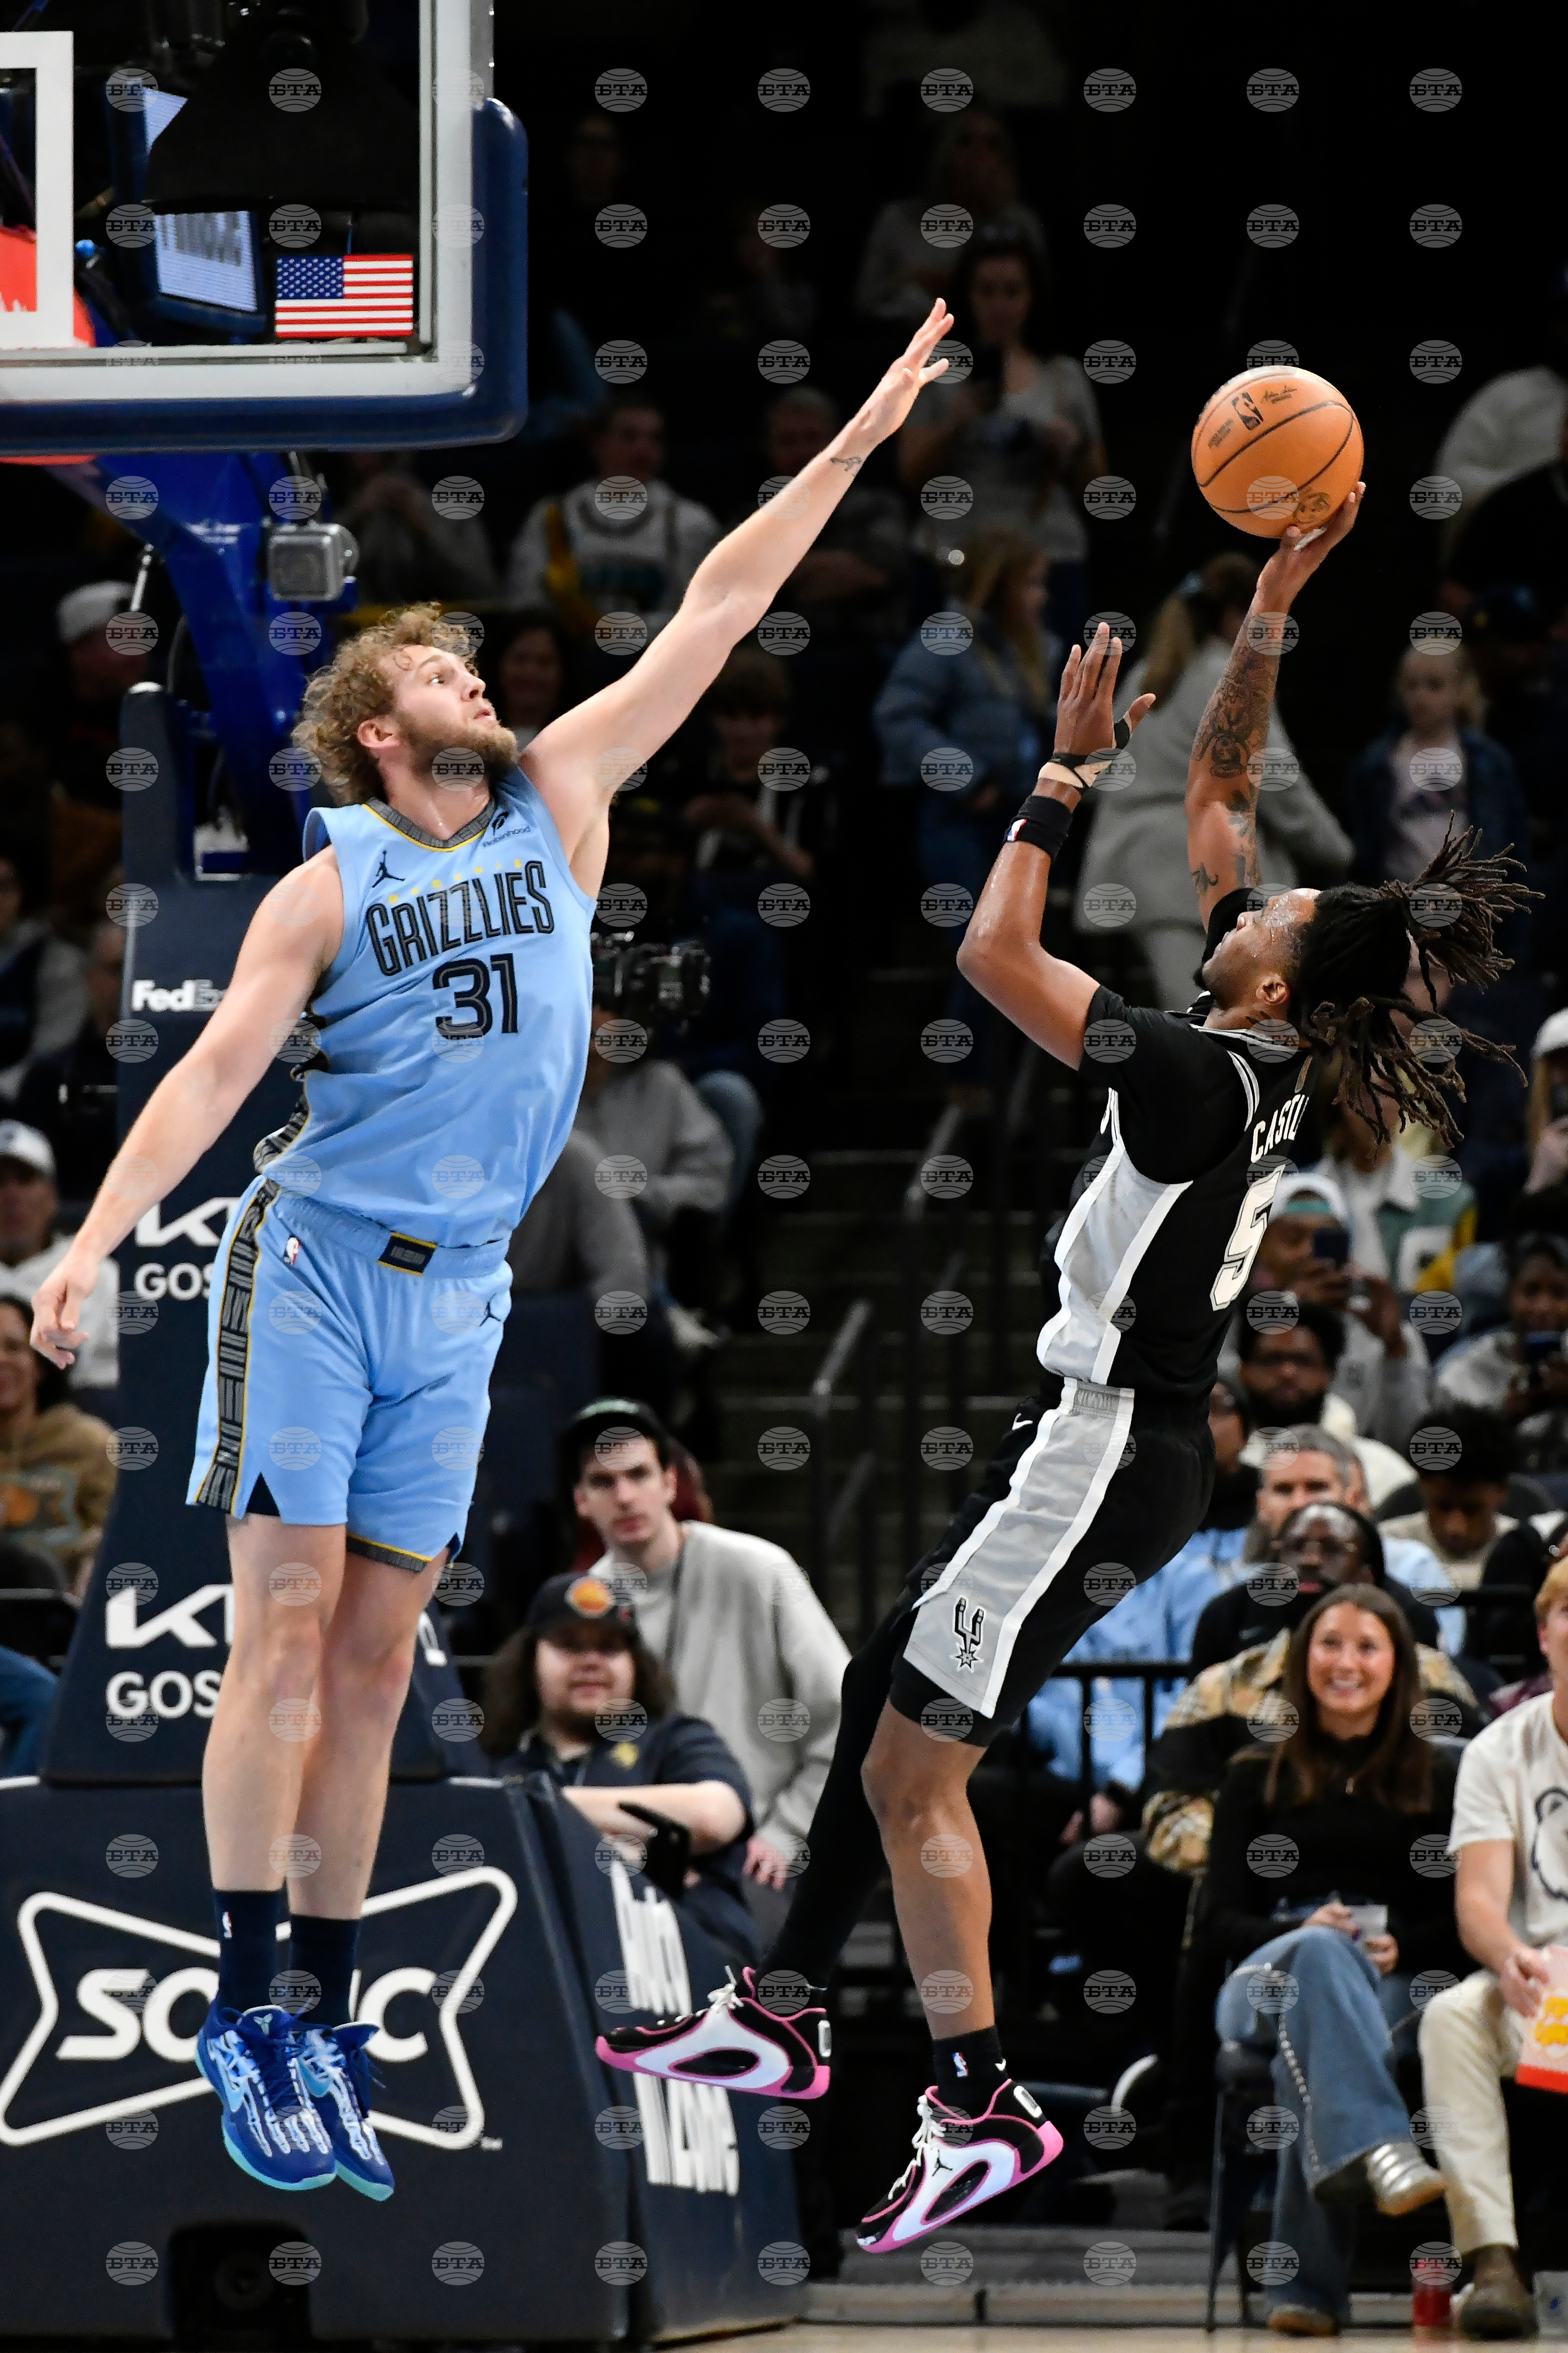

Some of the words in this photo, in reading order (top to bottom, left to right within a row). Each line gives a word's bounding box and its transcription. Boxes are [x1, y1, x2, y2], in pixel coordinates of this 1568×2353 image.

[365, 860, 555, 977] GRIZZLIES
[432, 953, 519, 1039] 31
[1209, 1164, 1286, 1311] 5
